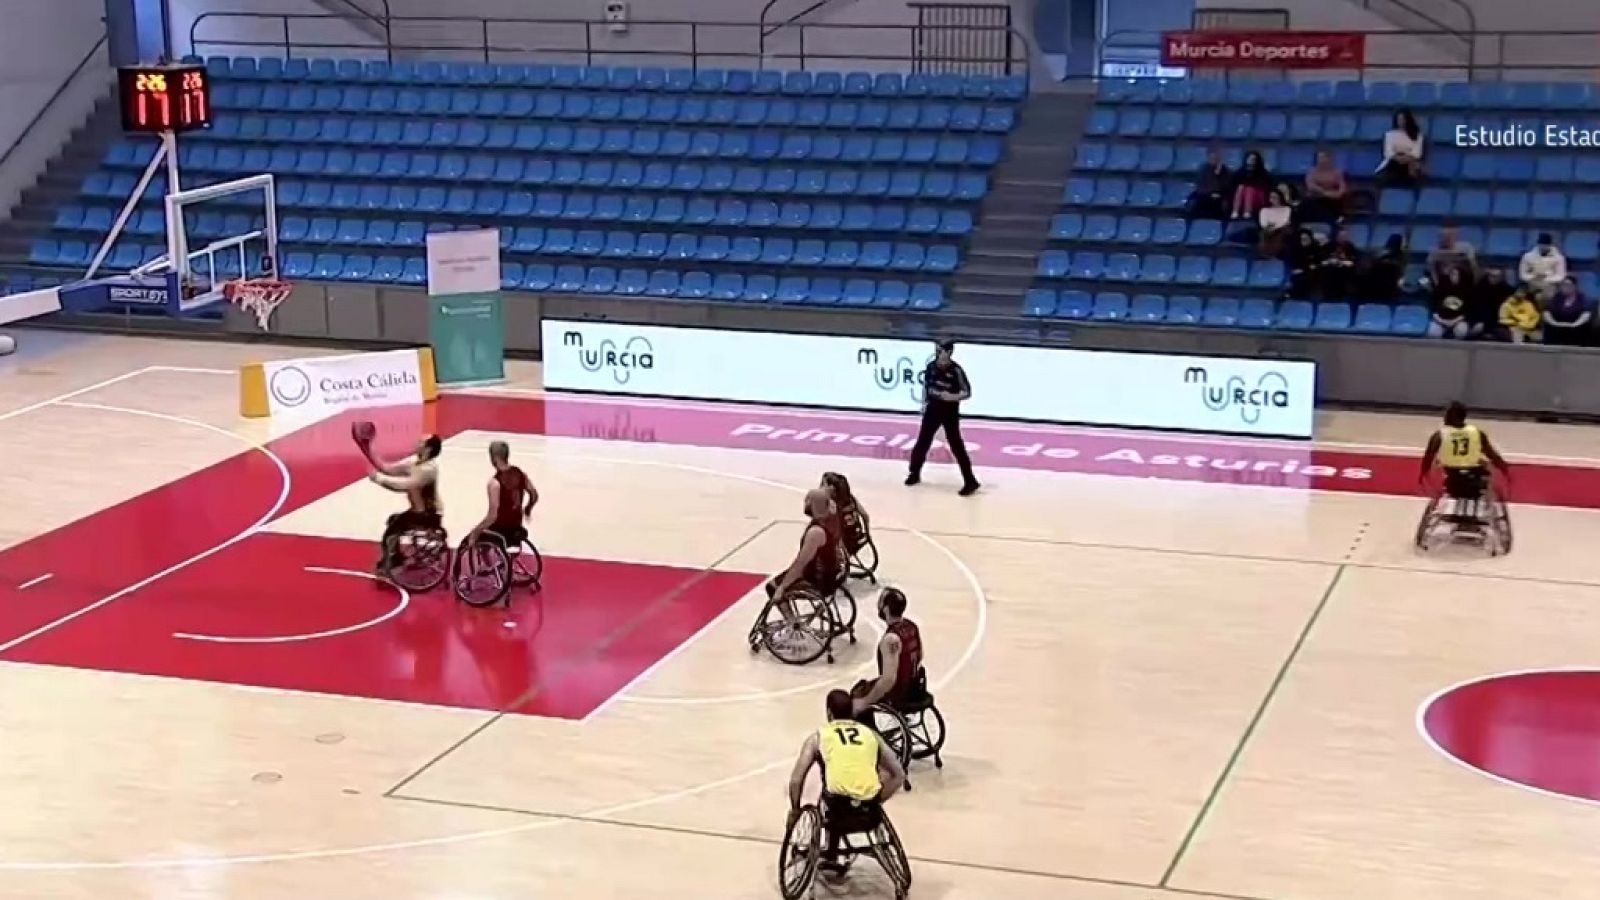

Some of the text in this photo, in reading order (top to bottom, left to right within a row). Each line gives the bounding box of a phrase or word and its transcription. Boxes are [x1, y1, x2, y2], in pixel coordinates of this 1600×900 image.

[1169, 41, 1329, 61] Murcia Deportes
[139, 91, 170, 126] 17
[319, 370, 417, 393] Costa Cálida
[1451, 438, 1470, 457] 13
[1003, 442, 1080, 460] de
[1094, 447, 1373, 479] Asturias
[834, 726, 864, 746] 12
